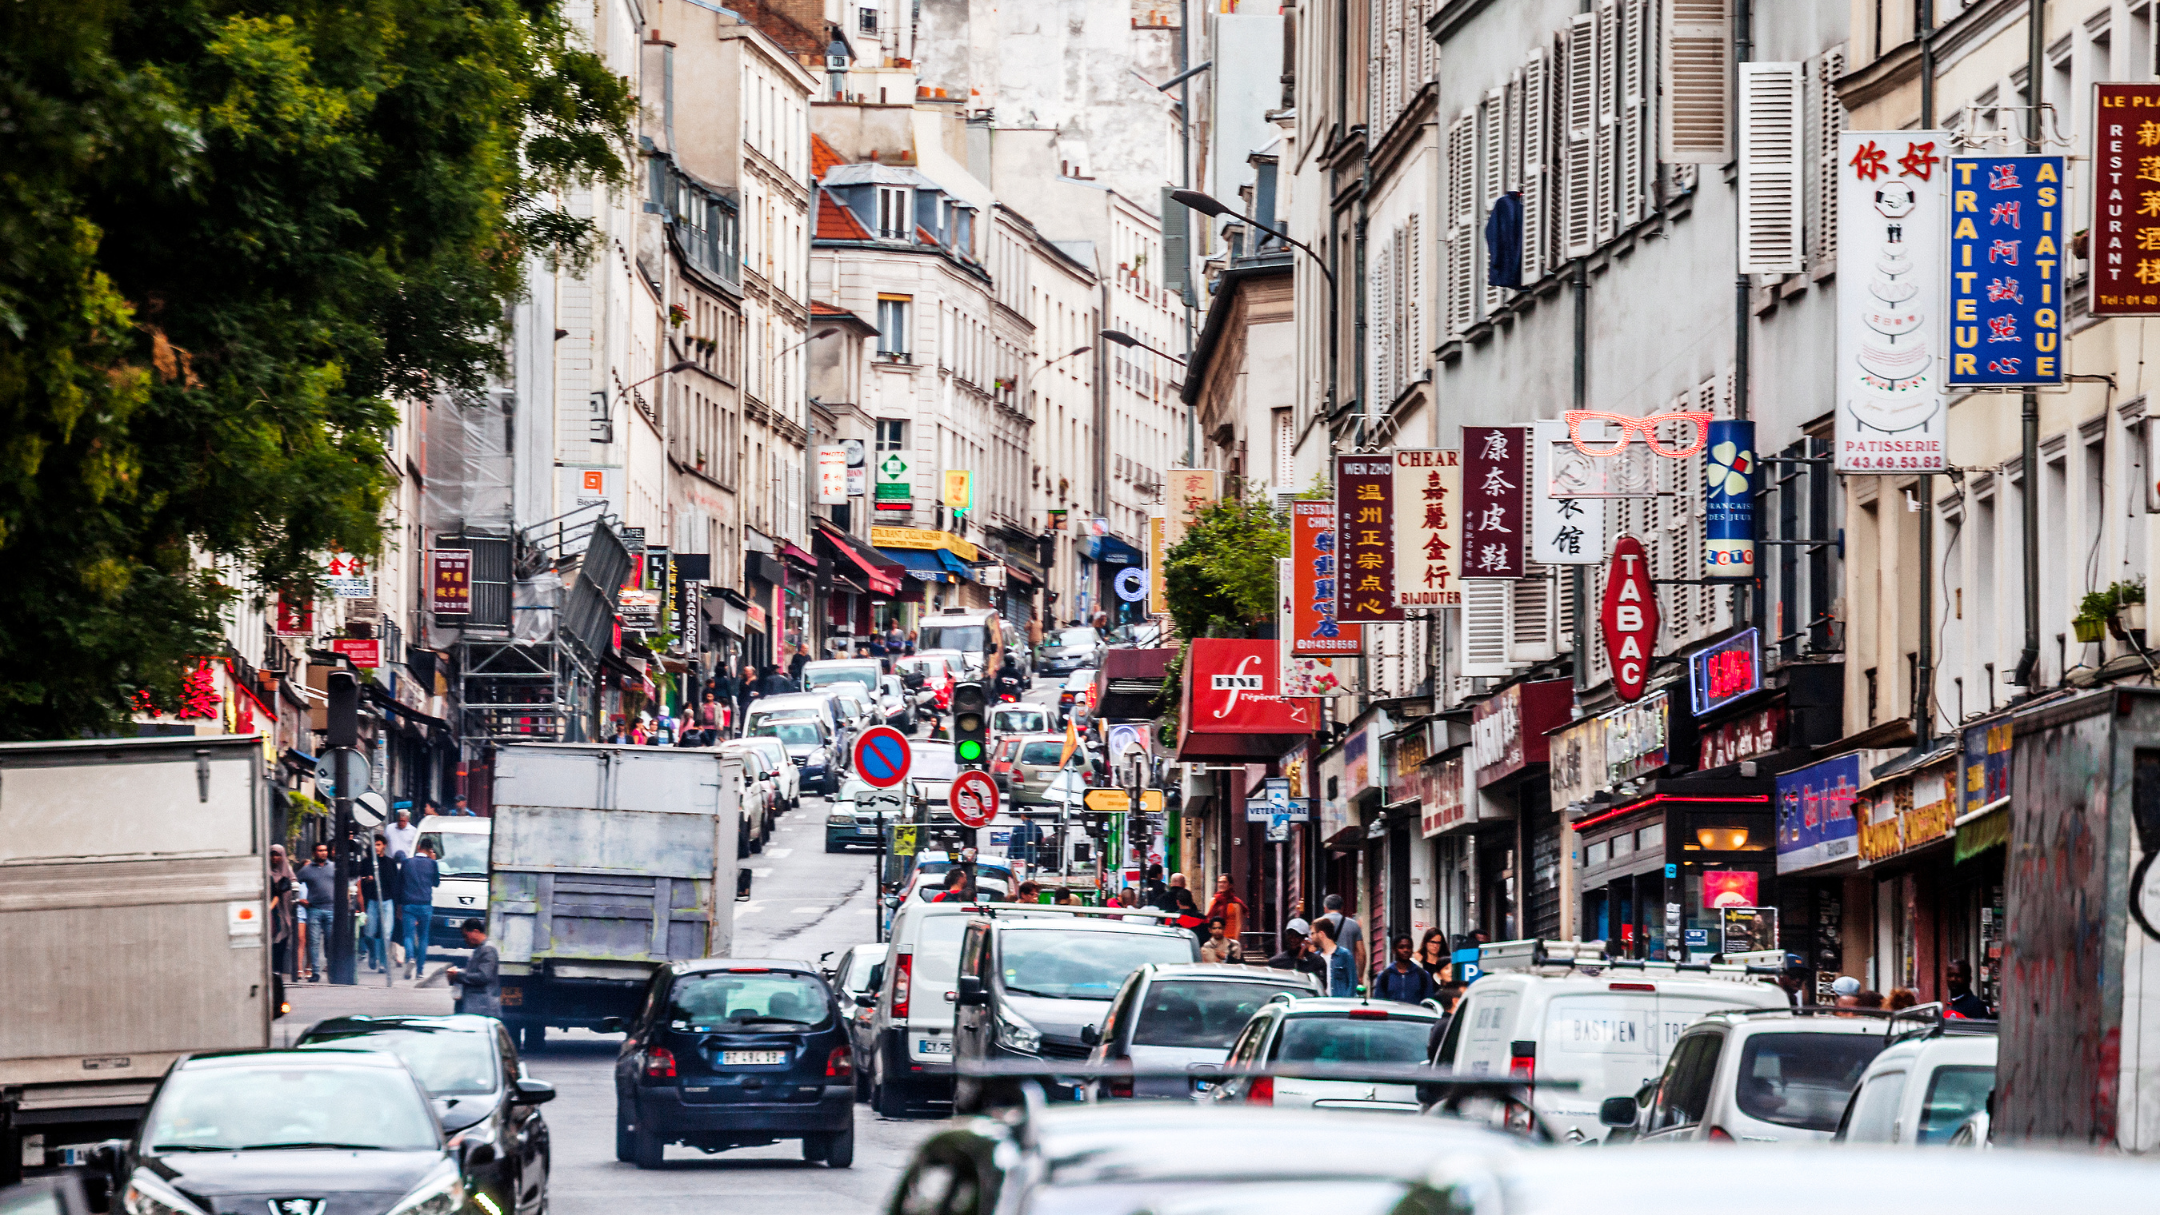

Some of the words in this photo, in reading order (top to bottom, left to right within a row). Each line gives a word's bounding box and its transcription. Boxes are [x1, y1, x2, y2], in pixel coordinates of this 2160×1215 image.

[2103, 96, 2125, 107] LE
[1849, 140, 1940, 182] 你好
[2109, 124, 2123, 280] RESTAURANT
[1954, 163, 1979, 375] TRAITEUR
[2035, 163, 2058, 376] ASIATIQUE
[1845, 440, 1940, 452] PATISSERIE
[1344, 463, 1367, 475] WEN
[1397, 451, 1460, 467] CHEAR
[1478, 429, 1516, 572] 康奈皮鞋
[1421, 470, 1451, 589] 嘉麗金行
[1356, 484, 1386, 615] 温州正宗点心
[1707, 550, 1754, 565] LOTO
[1343, 513, 1351, 609] RESTAURANT
[911, 571, 937, 581] KEBAB
[1617, 554, 1644, 684] TABAC
[1216, 678, 1260, 687] FINE
[1249, 807, 1308, 815] VETERINAIRE
[1464, 963, 1479, 982] P
[1574, 1020, 1636, 1042] BASTIEN
